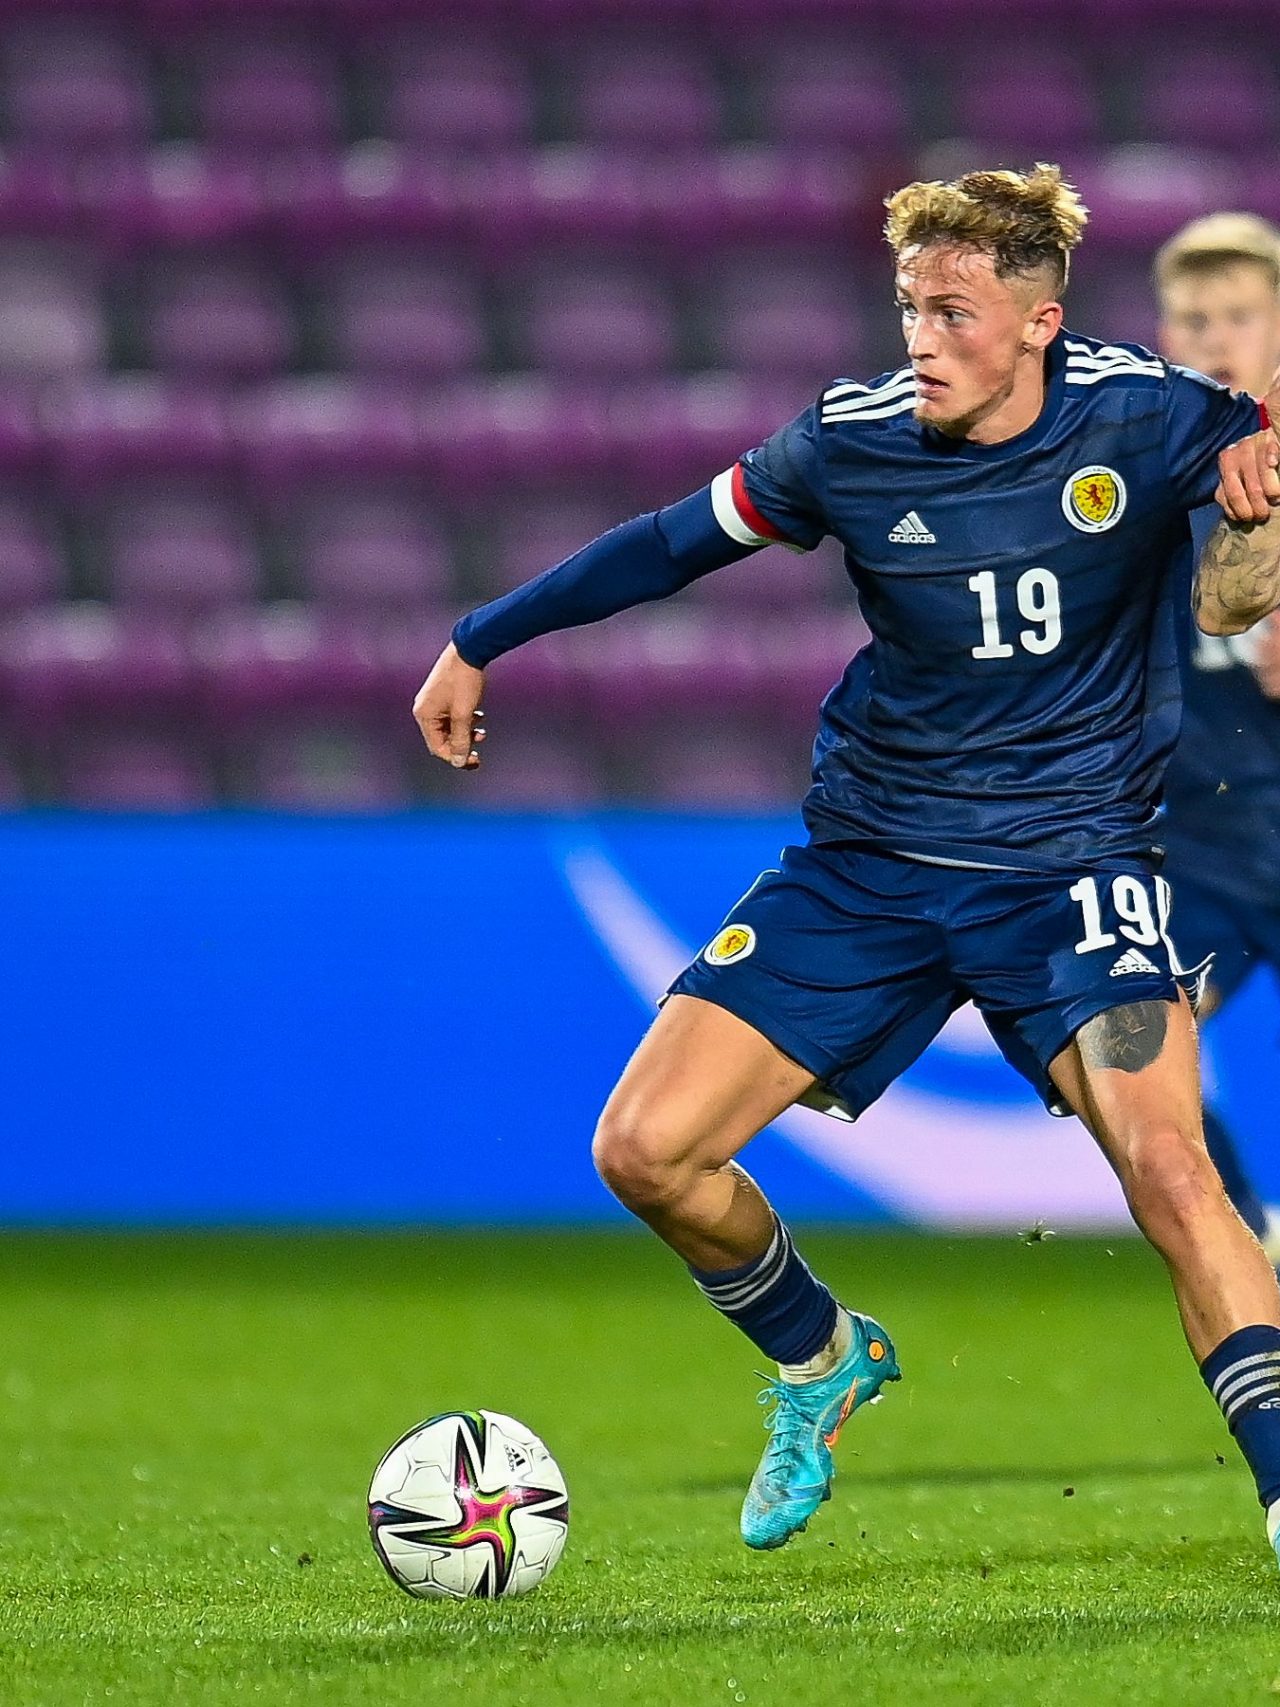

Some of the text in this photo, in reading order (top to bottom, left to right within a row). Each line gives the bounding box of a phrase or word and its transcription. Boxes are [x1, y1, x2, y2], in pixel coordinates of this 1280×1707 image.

[888, 532, 936, 543] adidas
[968, 567, 1062, 659] 19
[1069, 875, 1159, 954] 19
